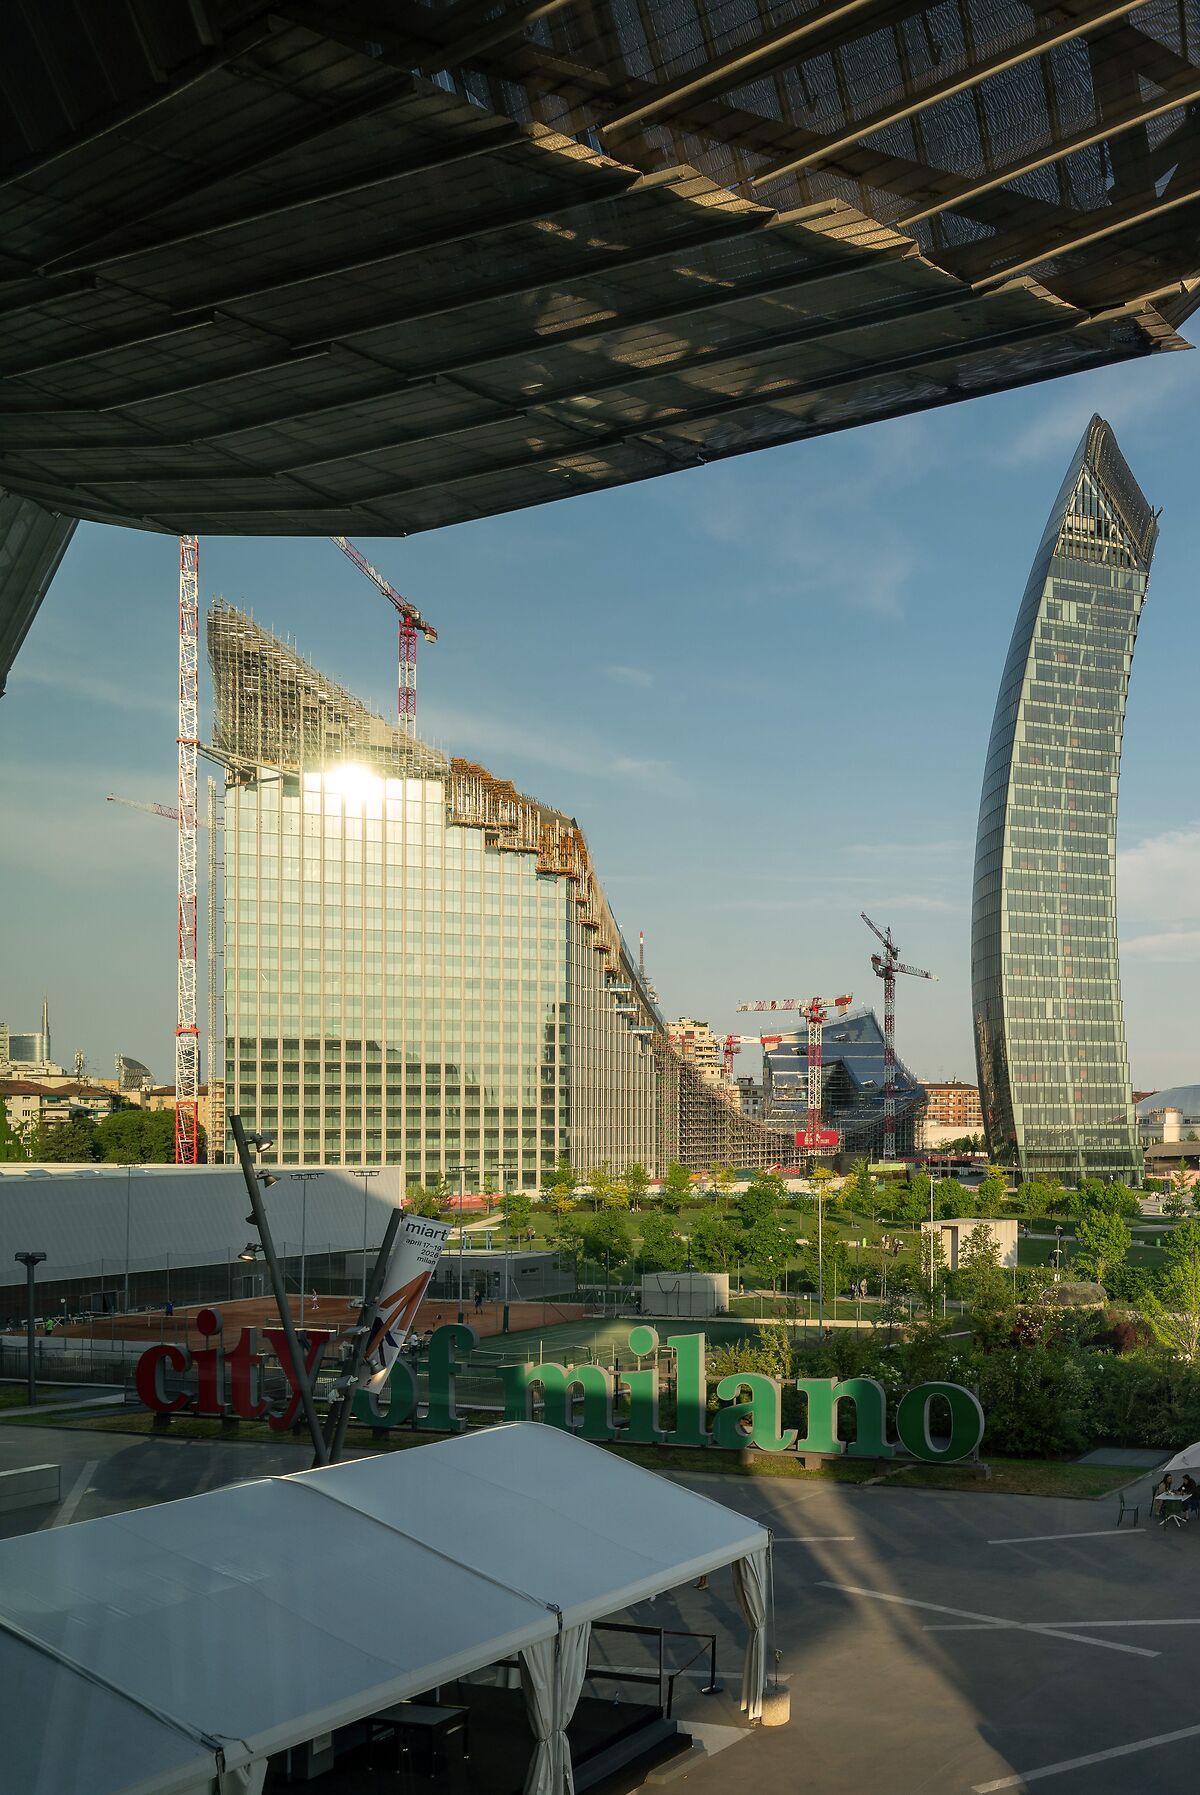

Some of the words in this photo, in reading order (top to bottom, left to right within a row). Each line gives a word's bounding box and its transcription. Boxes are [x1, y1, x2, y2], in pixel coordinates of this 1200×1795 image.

[405, 1222, 448, 1242] miart
[405, 1238, 422, 1247] april
[420, 1249, 439, 1259] 2026
[416, 1256, 436, 1265] milan
[135, 1308, 336, 1432] city
[349, 1323, 480, 1430] of
[496, 1326, 985, 1463] milano
